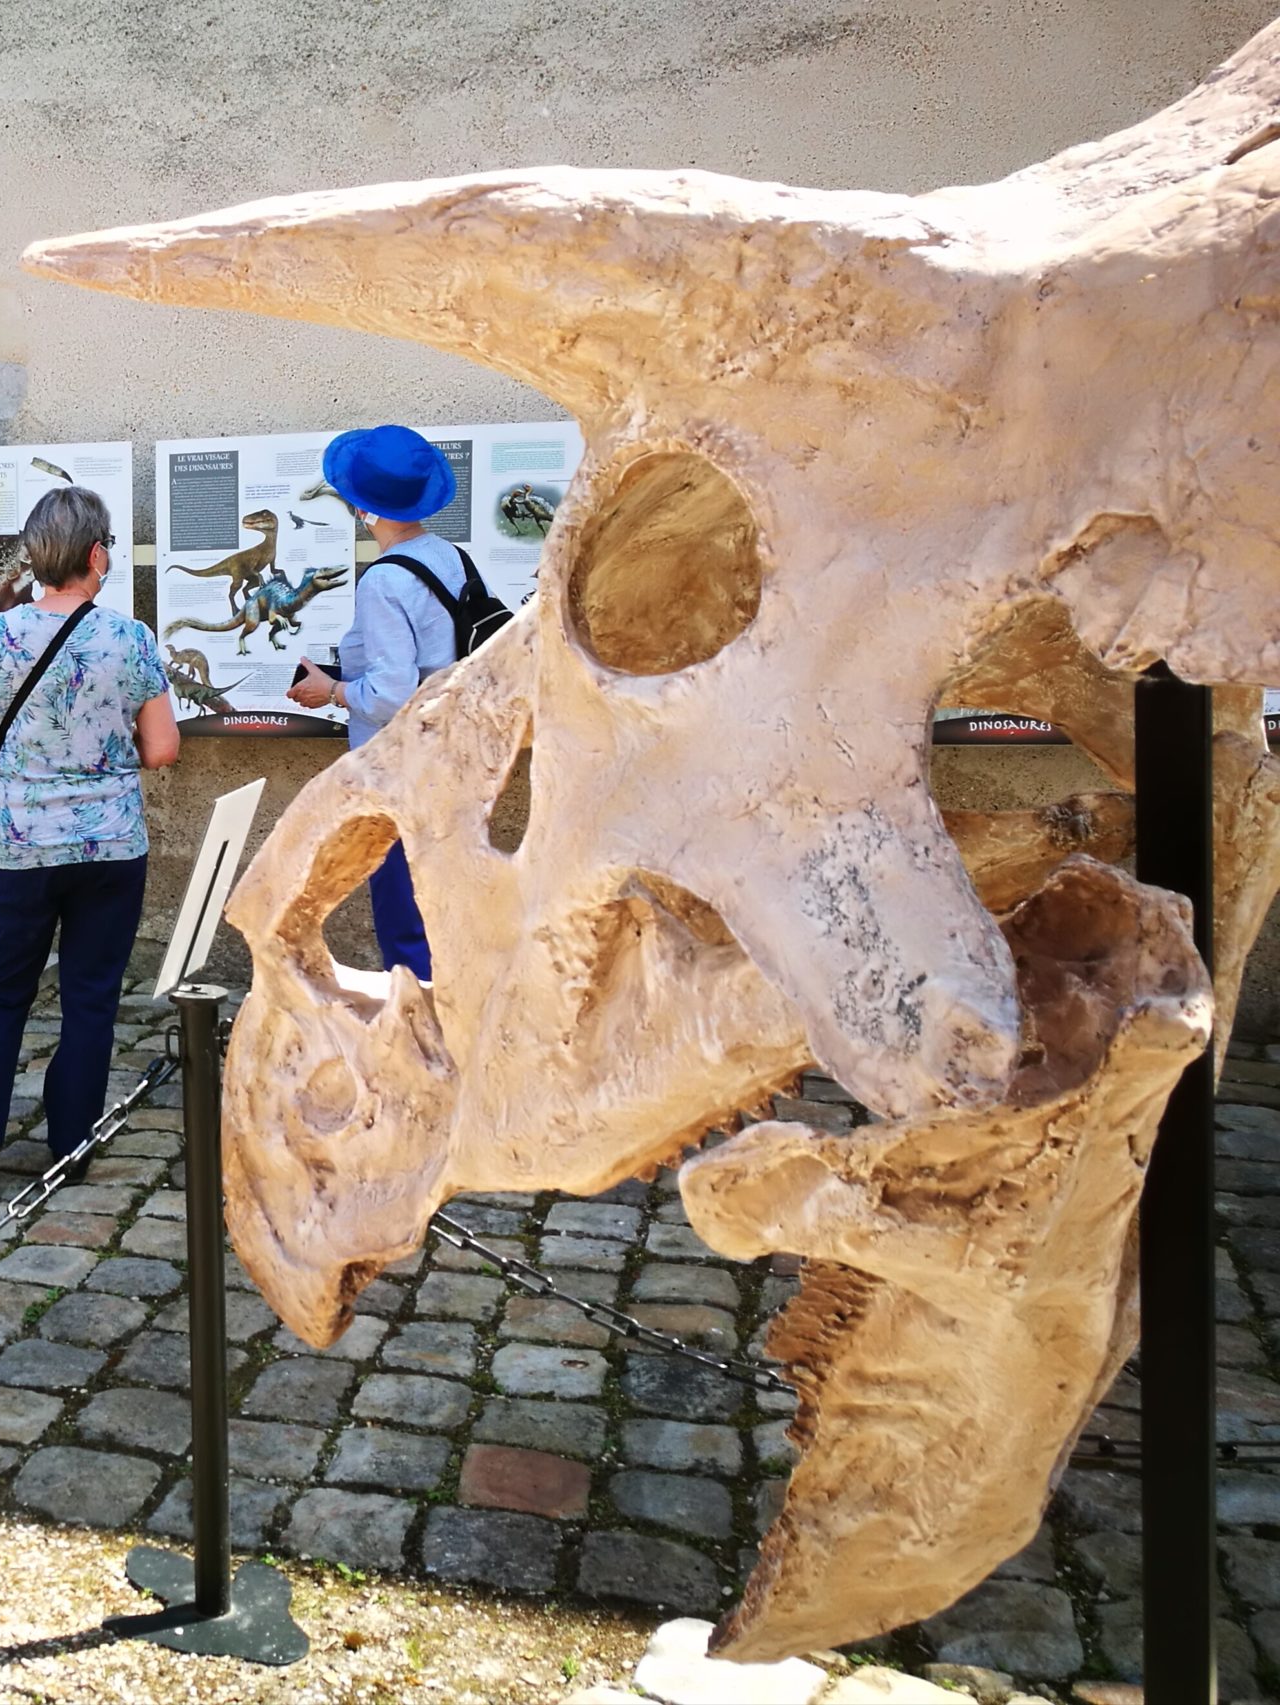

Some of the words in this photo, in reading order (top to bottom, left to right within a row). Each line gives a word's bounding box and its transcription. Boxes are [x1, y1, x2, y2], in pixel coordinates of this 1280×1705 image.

[177, 455, 186, 463] LE
[187, 454, 204, 462] VRAI
[205, 453, 230, 461] VISAGE
[174, 464, 188, 473] DES
[189, 462, 234, 472] DINOSAURES
[224, 715, 288, 725] DINOSAURES
[969, 720, 1052, 732] DINOSAURES
